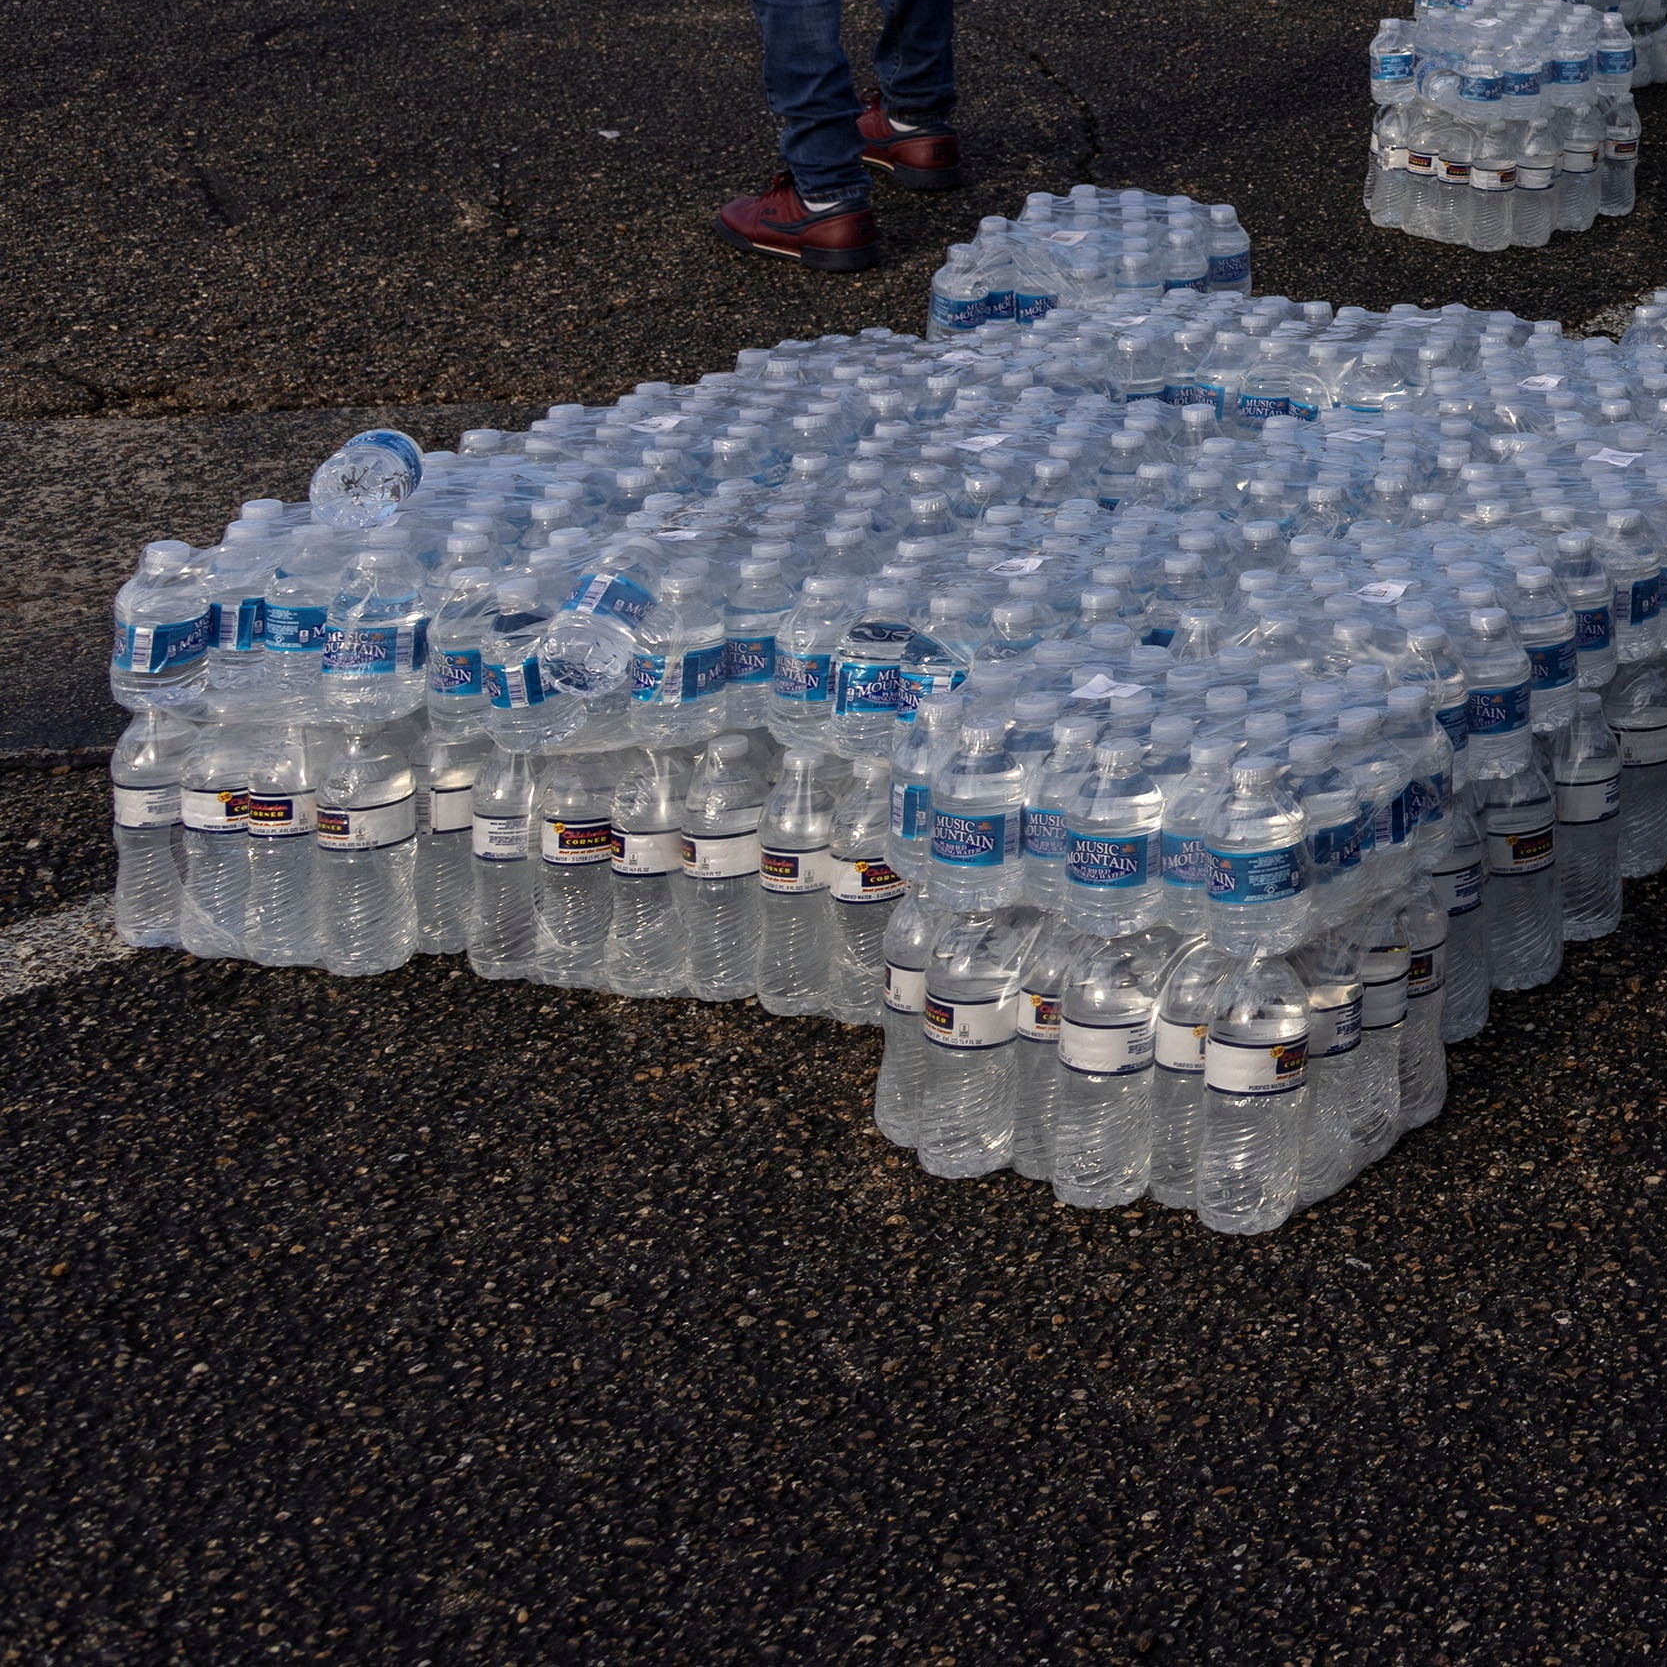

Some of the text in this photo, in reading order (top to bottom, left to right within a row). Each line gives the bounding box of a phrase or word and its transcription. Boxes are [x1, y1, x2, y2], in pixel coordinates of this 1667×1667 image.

[1245, 399, 1277, 410] MUSIC
[936, 815, 976, 834] MUSIC
[564, 835, 608, 847] CORNER
[1075, 840, 1121, 857] MUSIC
[1066, 851, 1139, 874] MOUNTAIN
[869, 873, 897, 883] CORN
[1248, 1082, 1286, 1092] PURIFIED WATER
